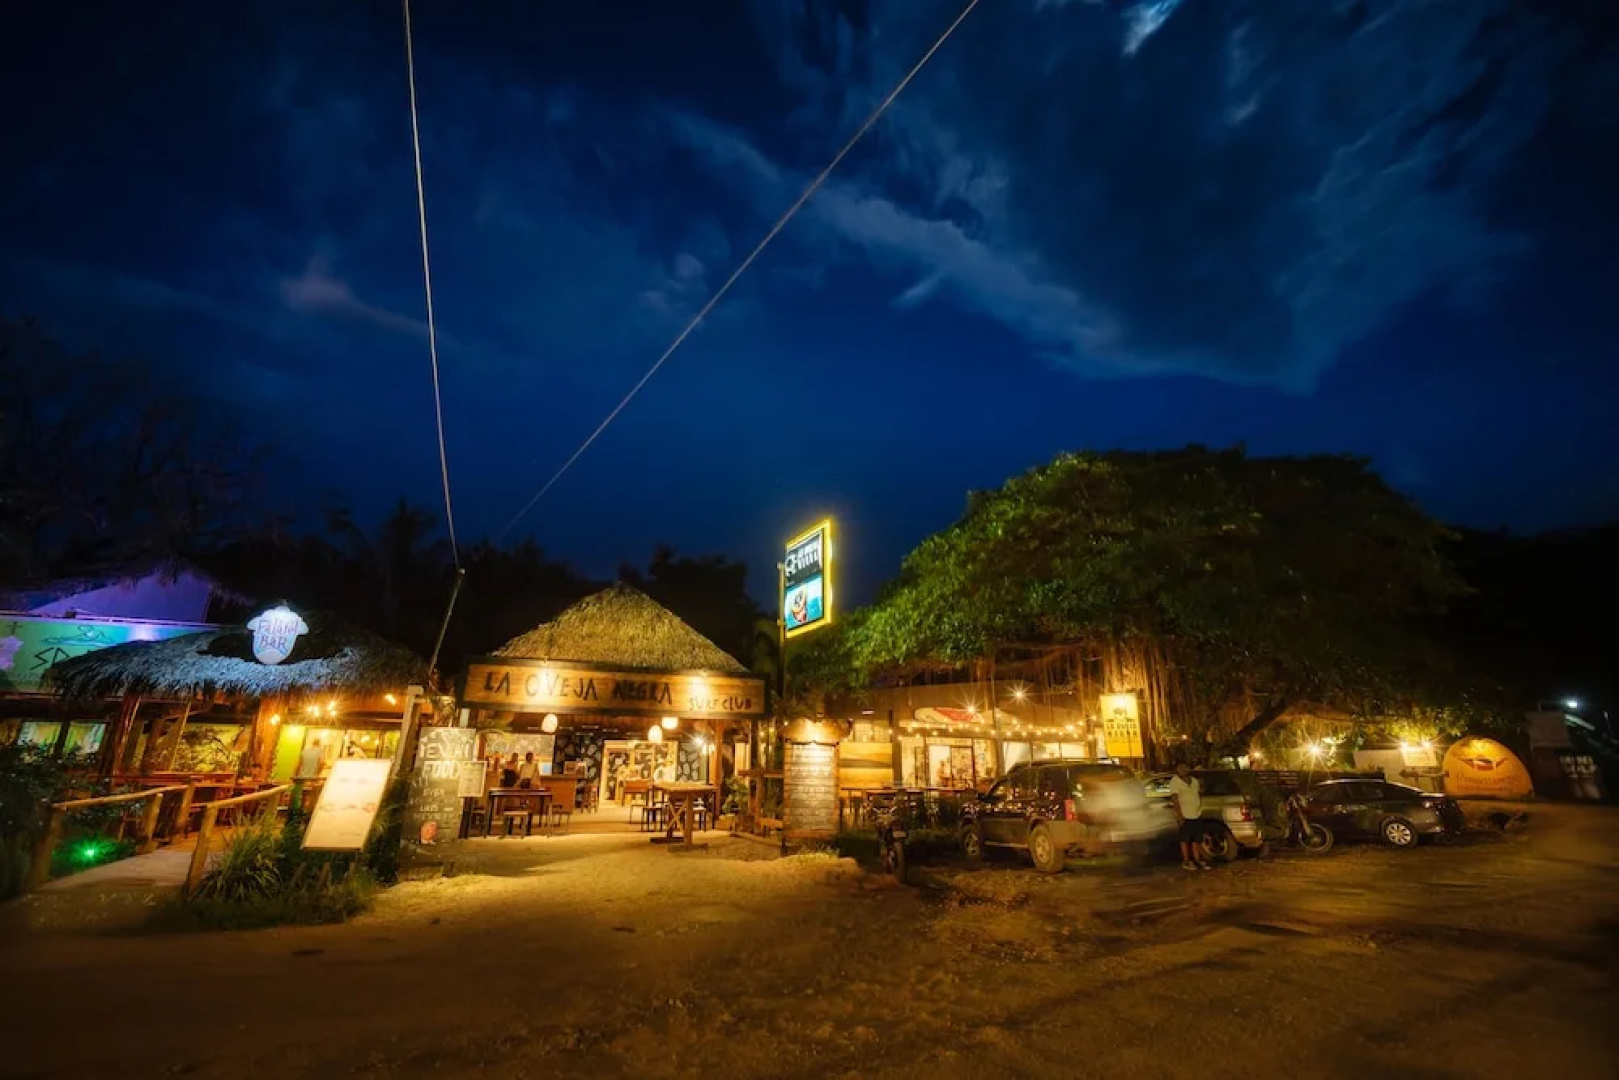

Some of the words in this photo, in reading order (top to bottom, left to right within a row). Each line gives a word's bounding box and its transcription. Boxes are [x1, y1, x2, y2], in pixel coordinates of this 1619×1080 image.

[484, 671, 511, 696] LA
[525, 673, 599, 701] OVEJA
[612, 679, 673, 705] NEGRA
[721, 697, 752, 712] CLUB
